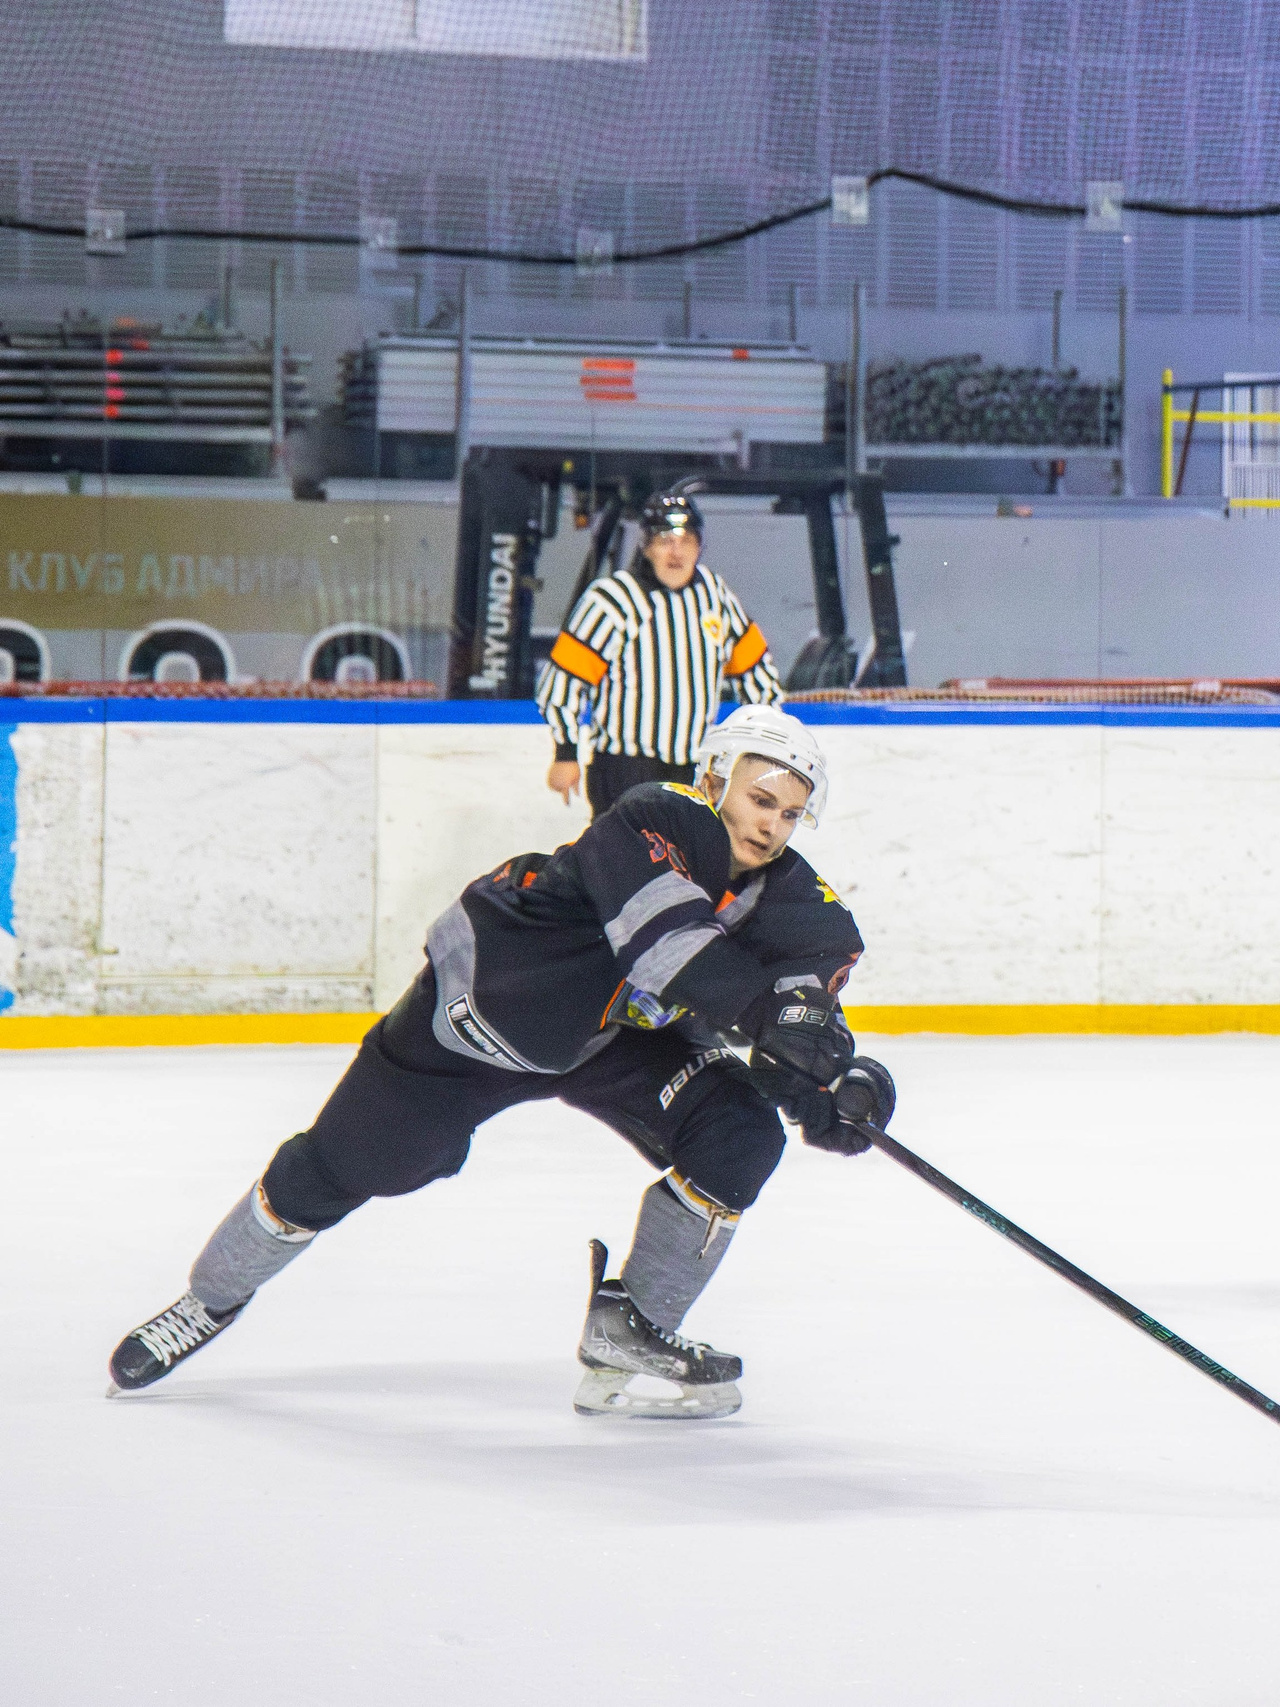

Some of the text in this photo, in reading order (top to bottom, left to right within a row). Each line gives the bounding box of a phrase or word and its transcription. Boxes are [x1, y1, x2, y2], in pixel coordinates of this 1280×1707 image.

[8, 552, 125, 595] КЛУБ
[468, 532, 518, 690] HYUNDAI
[658, 1048, 736, 1111] BAUER
